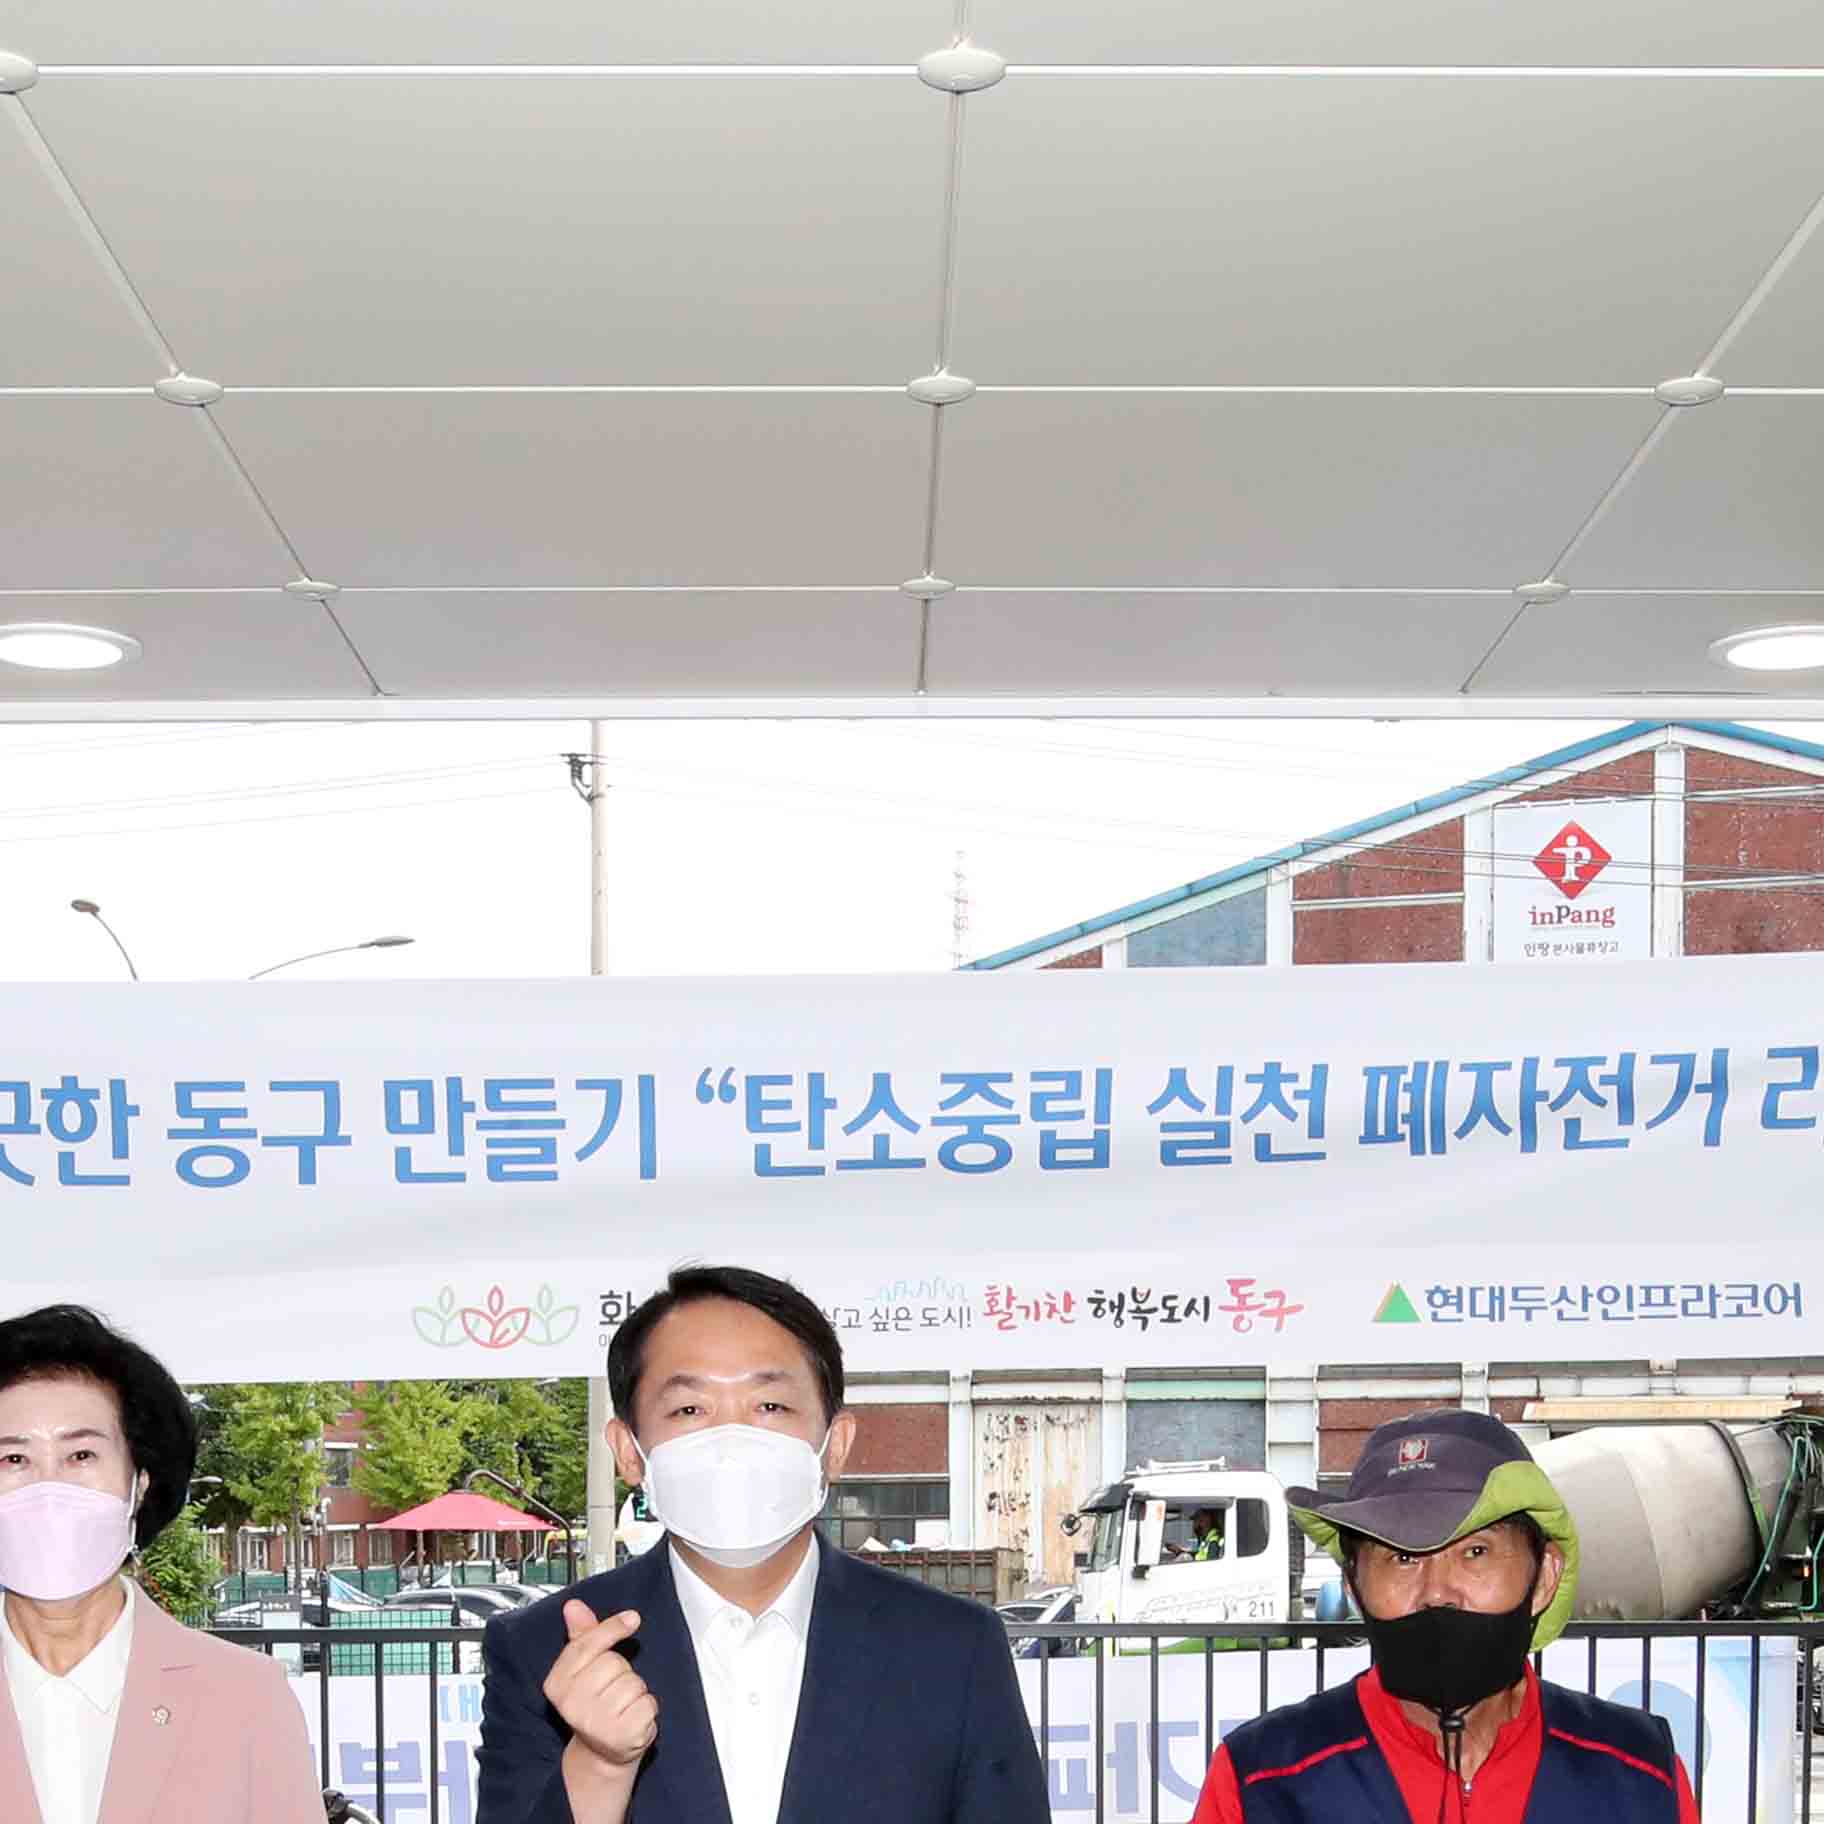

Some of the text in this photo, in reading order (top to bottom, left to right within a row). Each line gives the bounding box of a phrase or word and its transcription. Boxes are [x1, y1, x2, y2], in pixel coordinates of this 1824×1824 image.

[1528, 904, 1616, 928] inPang
[167, 1080, 352, 1188] 동구
[383, 1073, 658, 1184] 만들기
[1147, 1061, 1329, 1167] 실천
[1358, 1047, 1729, 1158] 폐자전거
[869, 1306, 913, 1332] 싶은
[919, 1306, 972, 1329] 도시!
[982, 1278, 1304, 1333] 활기찬 행복도시 동구
[1425, 1282, 1803, 1323] 현대두산인프라코어
[1248, 1599, 1275, 1618] 211
